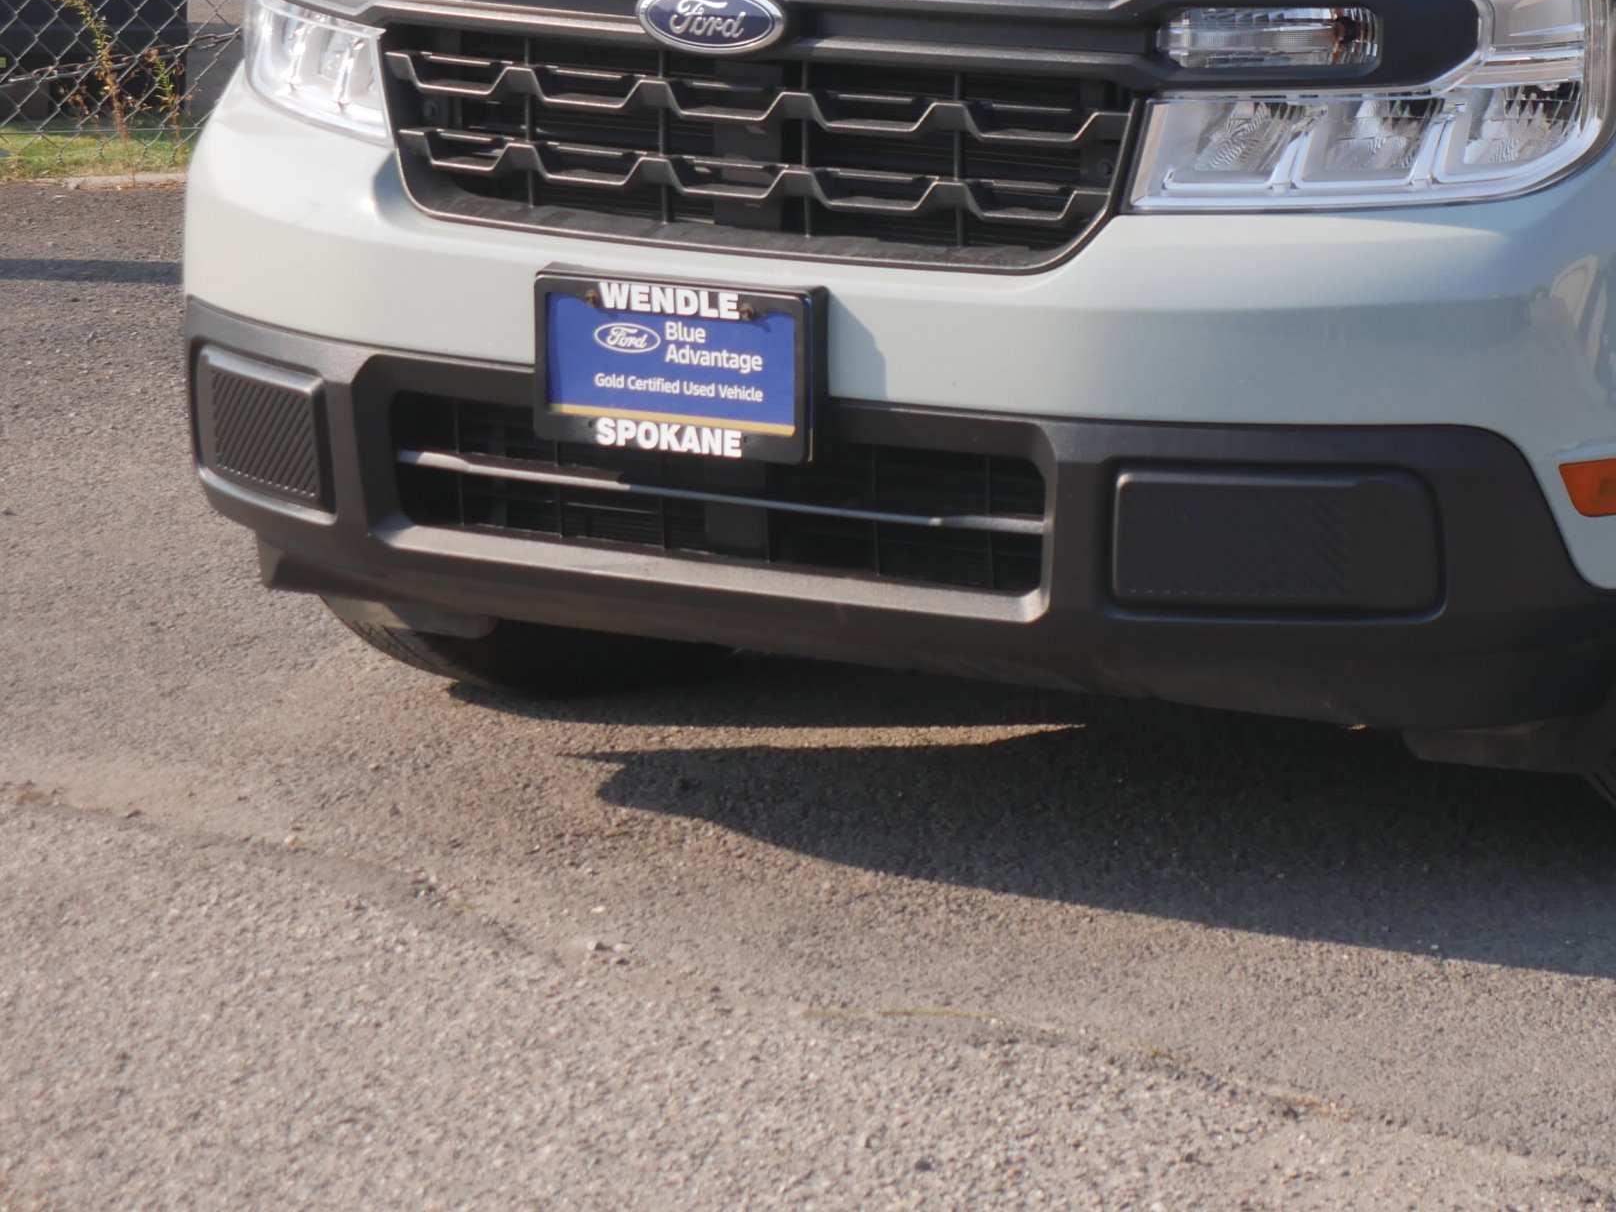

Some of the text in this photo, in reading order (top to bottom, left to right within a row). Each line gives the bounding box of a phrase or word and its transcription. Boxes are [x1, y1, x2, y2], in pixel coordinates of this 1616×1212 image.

[599, 281, 741, 320] WENDLE
[605, 324, 648, 350] Ford
[664, 321, 707, 344] Blue
[664, 345, 764, 374] Advantage
[594, 372, 764, 402] Gold Certified Used Vehicle
[595, 417, 742, 458] SPOKANE
